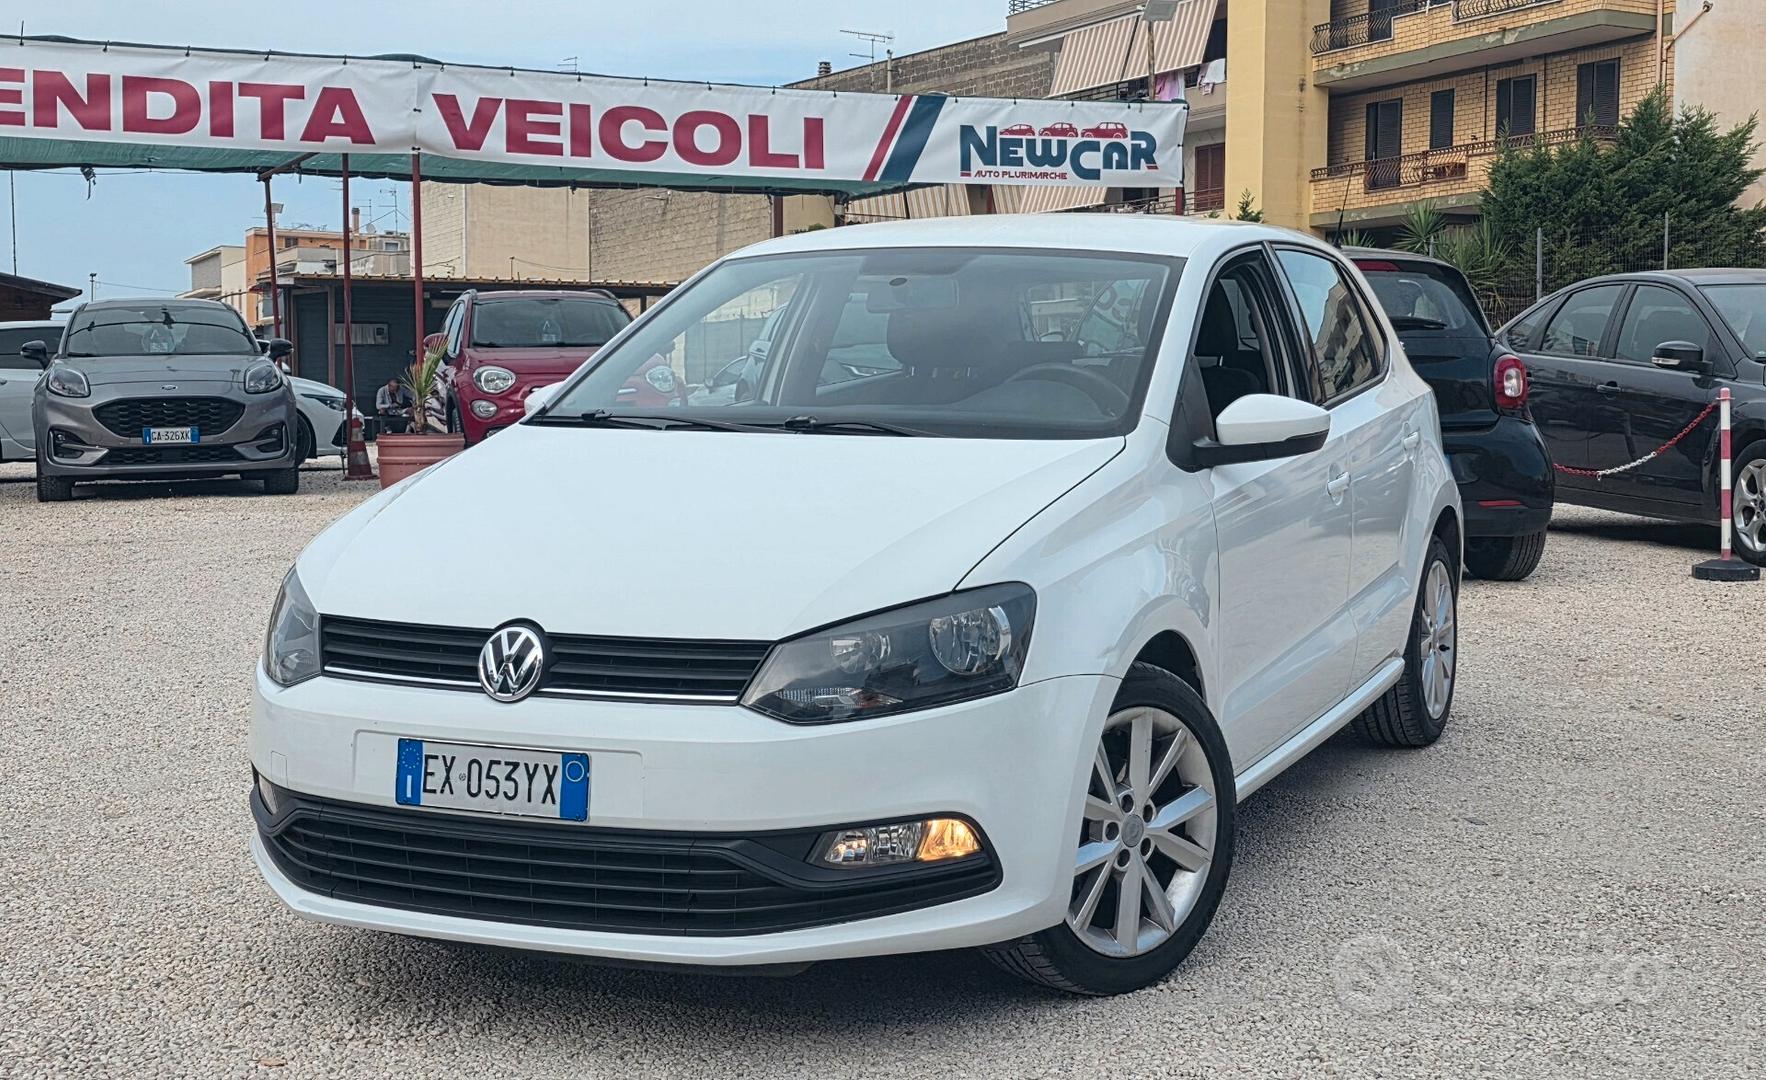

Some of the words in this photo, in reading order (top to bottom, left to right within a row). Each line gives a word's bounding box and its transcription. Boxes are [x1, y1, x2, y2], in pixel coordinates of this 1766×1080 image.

[431, 93, 825, 169] VEICOLI
[974, 170, 1000, 178] AUTO
[1001, 170, 1068, 180] PLURIMARCHE
[422, 754, 457, 795] EX
[466, 758, 559, 805] 053YX
